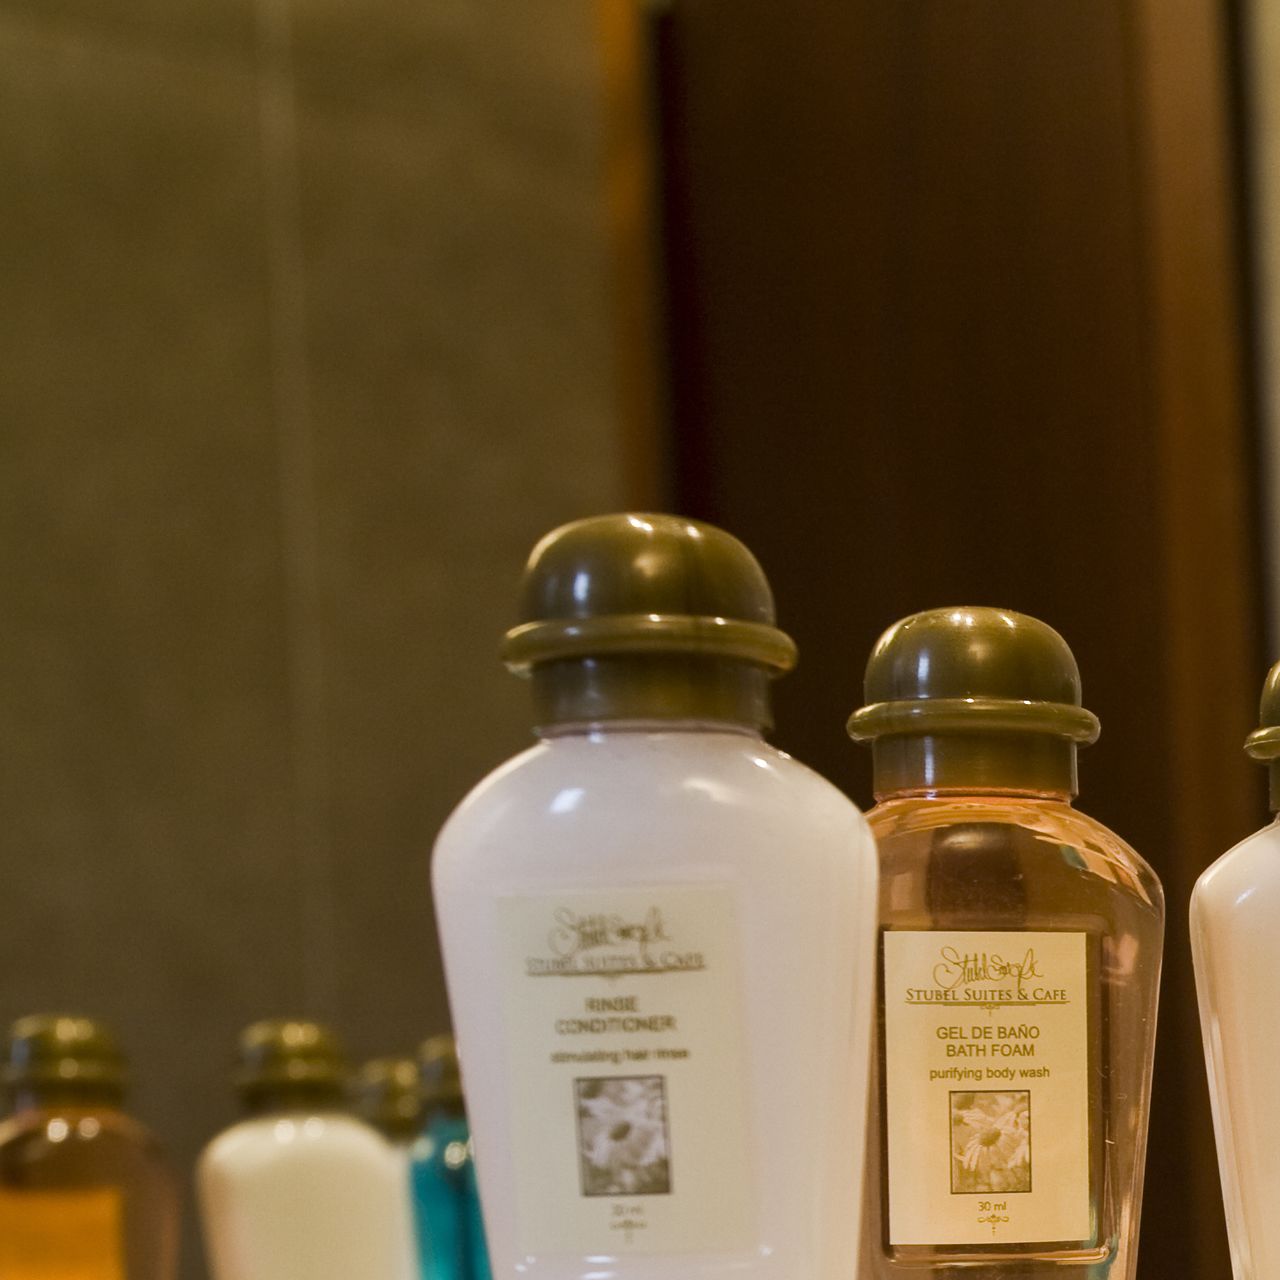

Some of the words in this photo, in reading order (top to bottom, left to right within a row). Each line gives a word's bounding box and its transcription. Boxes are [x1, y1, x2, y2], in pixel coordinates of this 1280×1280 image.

[906, 987, 960, 1001] STUBEL
[964, 987, 1014, 1001] SUITES
[1017, 987, 1029, 1001] &
[1033, 987, 1067, 1001] CAFE
[555, 1015, 678, 1035] CONDITIONER
[936, 1026, 967, 1040] GEL
[972, 1026, 993, 1040] DE
[997, 1023, 1040, 1040] BAÑO
[946, 1044, 987, 1058] BATH
[991, 1043, 1035, 1057] FOAM
[929, 1066, 983, 1081] purifying
[986, 1066, 1016, 1080] body
[1019, 1066, 1050, 1078] wash
[978, 1201, 991, 1212] 30
[993, 1200, 1007, 1212] ml
